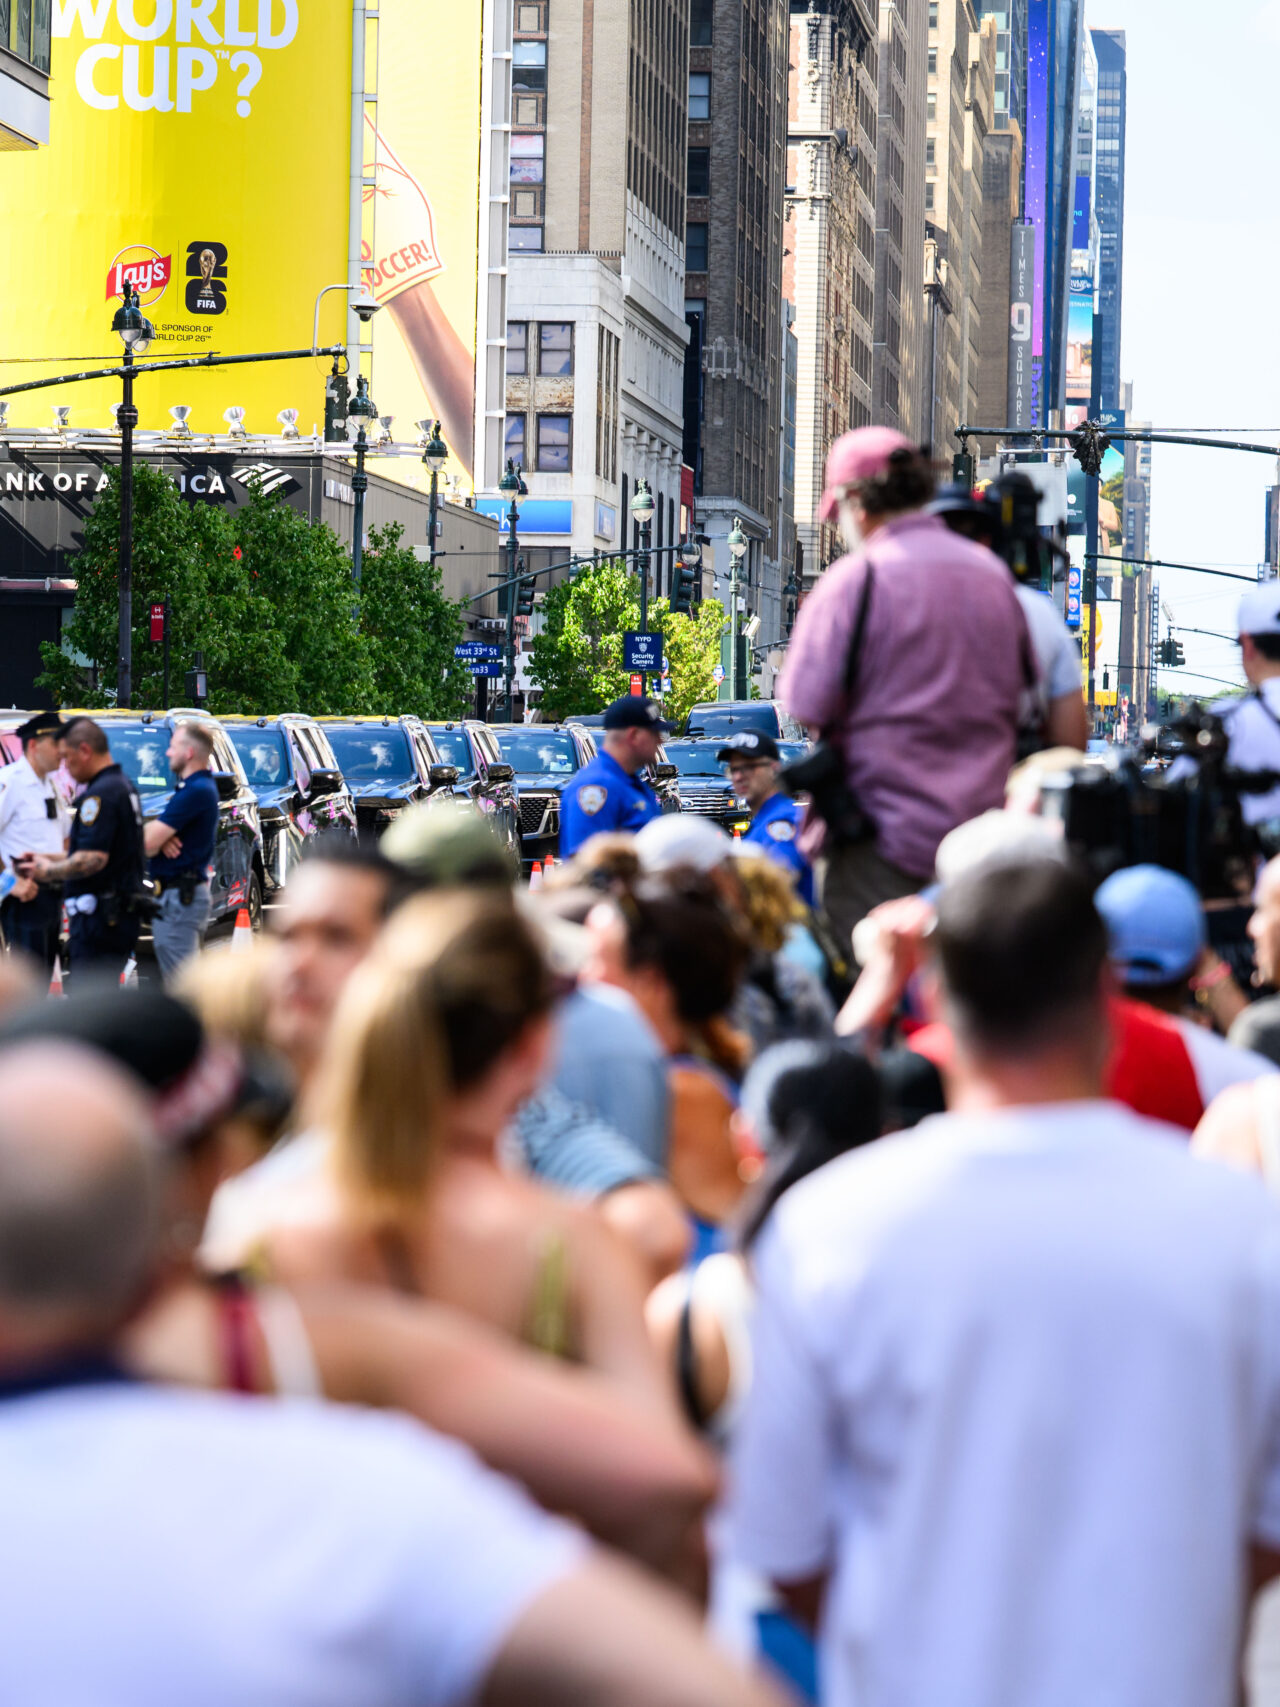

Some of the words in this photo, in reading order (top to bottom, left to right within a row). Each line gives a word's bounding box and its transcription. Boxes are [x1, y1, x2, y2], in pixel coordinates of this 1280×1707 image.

[1018, 231, 1026, 297] TIMES
[197, 299, 216, 309] FIFA
[162, 324, 201, 332] SPONSOR
[1011, 302, 1031, 341] 9
[154, 333, 174, 341] ORLD
[1016, 346, 1024, 426] SQUARE
[53, 473, 88, 491] OF
[95, 473, 226, 494] AICA
[455, 647, 471, 655] West
